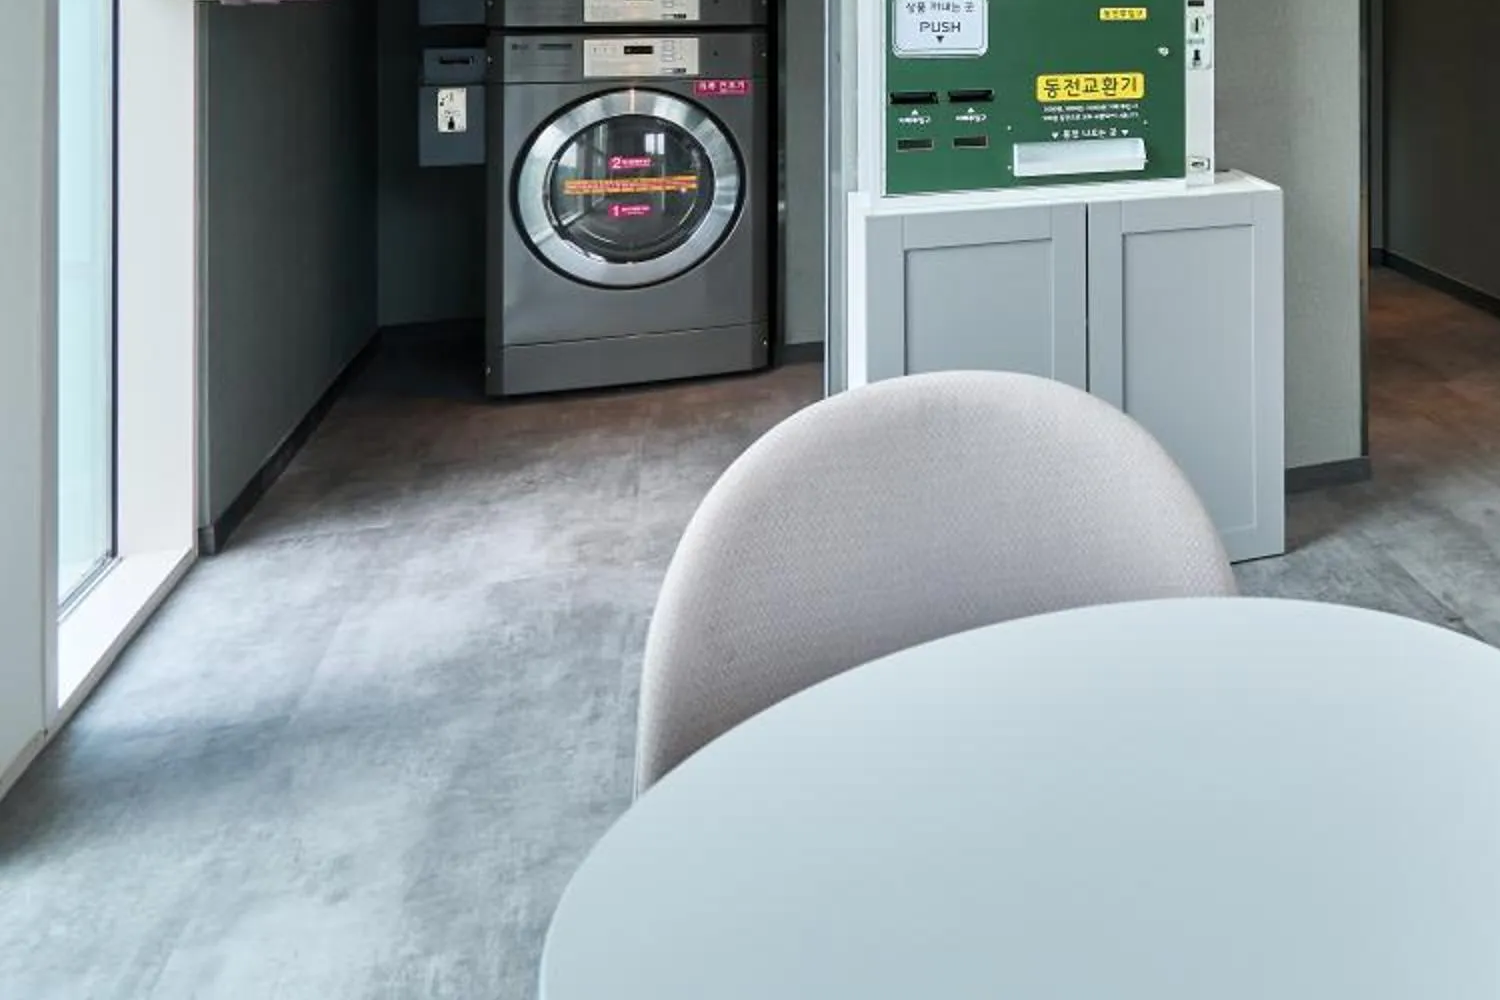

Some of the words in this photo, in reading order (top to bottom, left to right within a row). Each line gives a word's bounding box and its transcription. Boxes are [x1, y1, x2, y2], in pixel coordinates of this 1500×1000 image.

[919, 21, 961, 33] PUSH
[1043, 75, 1138, 99] 동전교환기
[611, 156, 622, 168] 2
